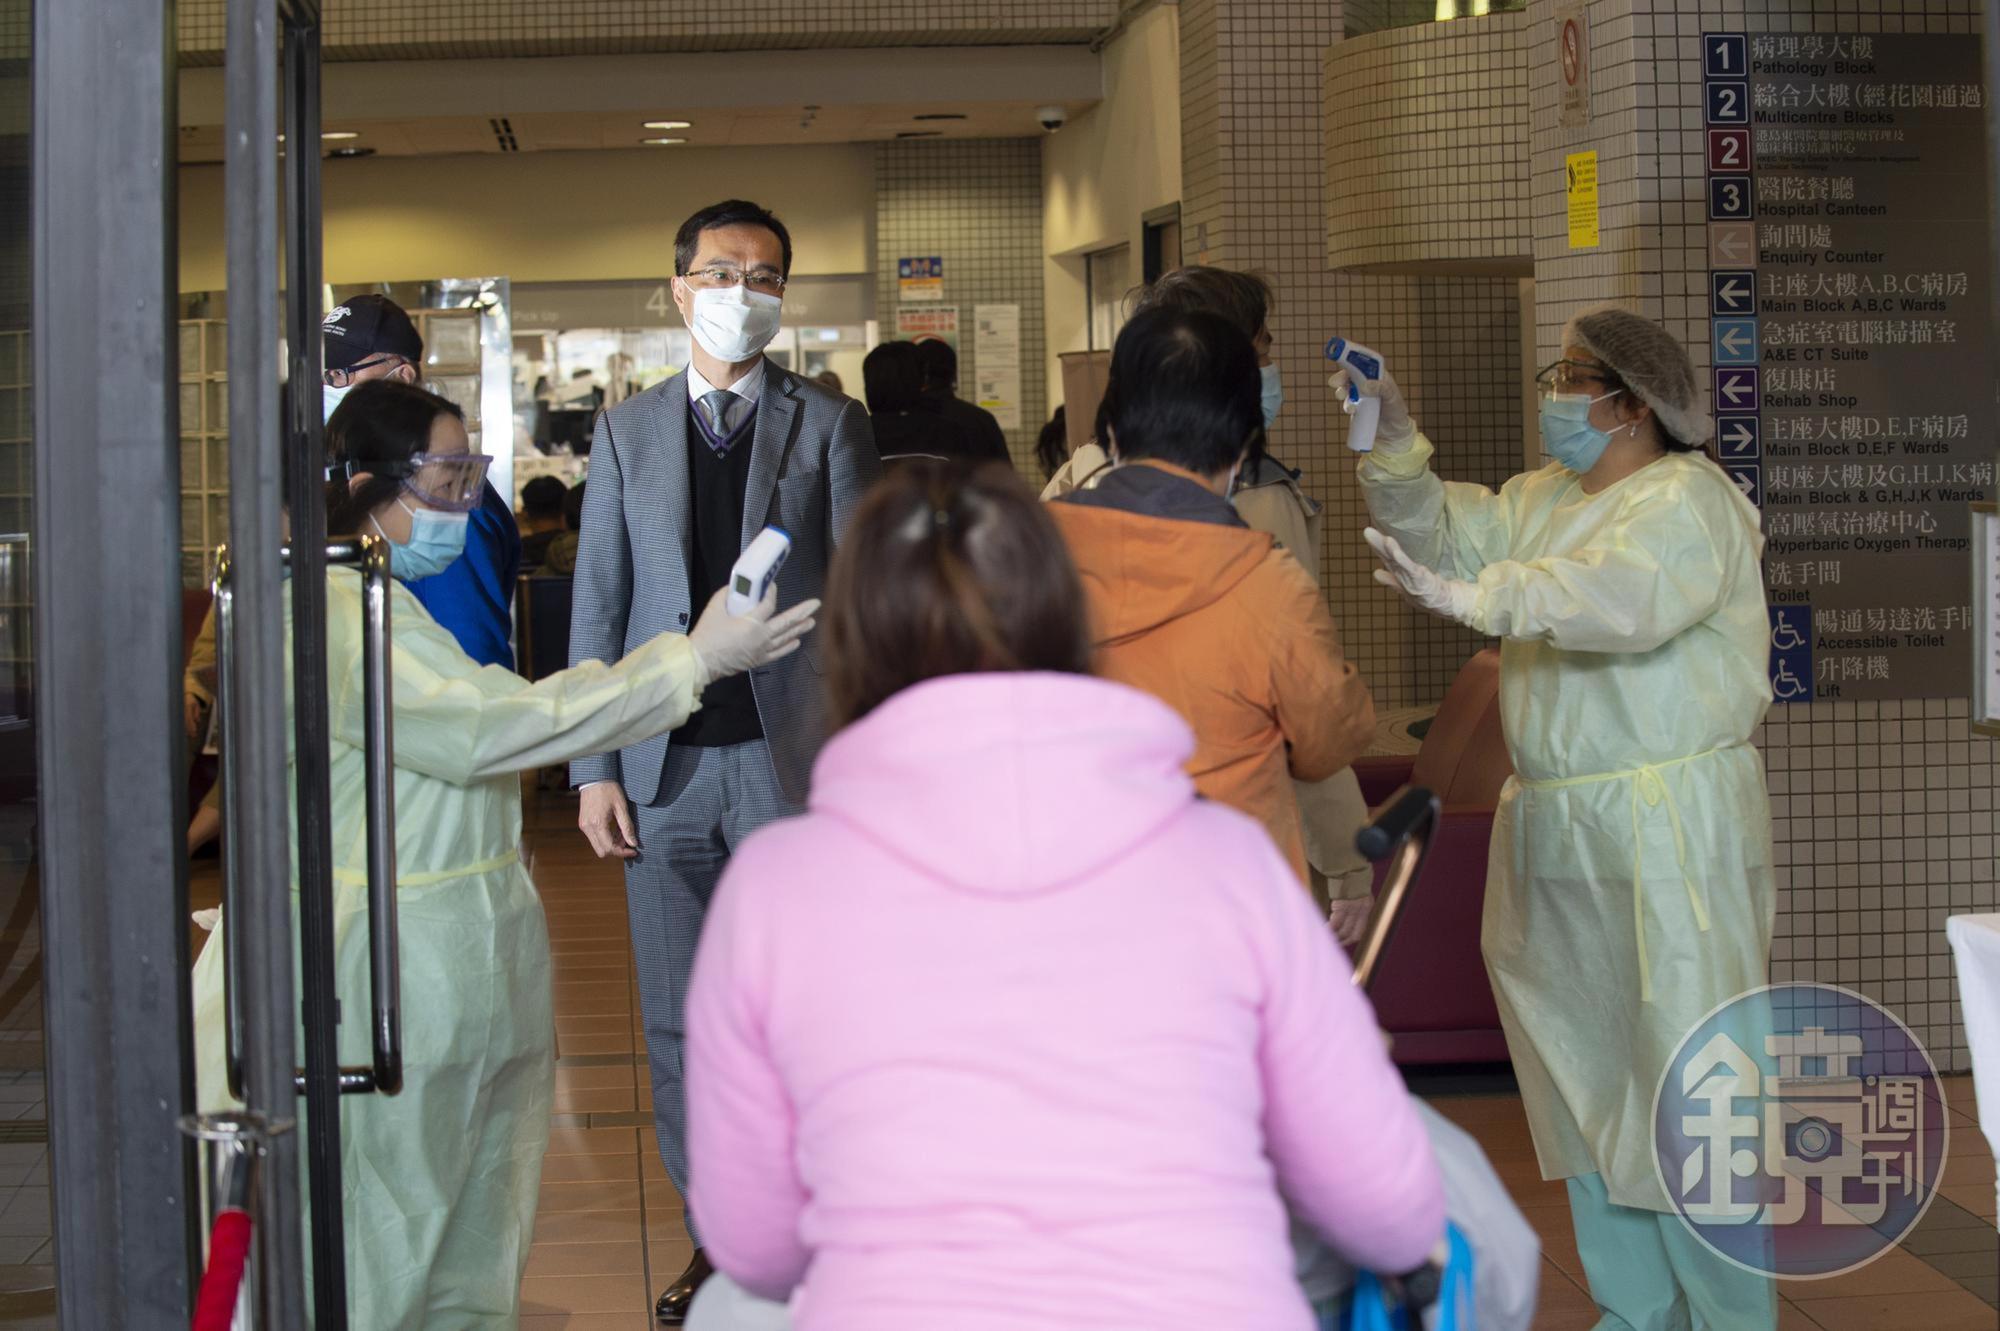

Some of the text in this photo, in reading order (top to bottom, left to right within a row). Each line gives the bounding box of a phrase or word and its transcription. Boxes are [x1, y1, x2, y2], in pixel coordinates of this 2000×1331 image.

[1716, 42, 1729, 69] 1
[1752, 35, 1874, 60] 病理學大樓
[1752, 60, 1877, 76] Pathology Block
[1718, 89, 1737, 117] 2
[1754, 110, 1895, 124] Multicentre Blocks
[1720, 136, 1740, 165] 2
[1722, 184, 1741, 212] 3
[1757, 176, 1856, 201] 醫院餐廳
[1757, 202, 1887, 218] Hospital Canteen
[1759, 224, 1833, 249] 詢問處
[1760, 250, 1884, 265] Enquiry Counter
[645, 285, 670, 318] 4
[1761, 298, 1947, 314] Main Block A,B,C Wards
[1762, 319, 1957, 345] 急症室電腦掃描室
[1763, 347, 1869, 362] A&E CT Suite
[1764, 367, 1837, 393] 復康店
[1763, 393, 1858, 409] Rehab Shop
[1765, 413, 1969, 441] 主座大樓D,E,F病房
[1765, 440, 1950, 457] Main Block D,E,F Wards
[1766, 488, 1985, 505] Main Block & G,H,J,K Wards
[1767, 509, 1938, 537] 高壓氧治療中心
[1767, 538, 1849, 554] Hyperbaric
[1854, 536, 1911, 553] Oxygen
[1769, 560, 1841, 585] 洗手間
[1769, 588, 1811, 602] Toilet
[1816, 633, 1946, 650] Accessible Toilet
[1816, 655, 1890, 681] 升降機
[1816, 684, 1841, 698] Lift
